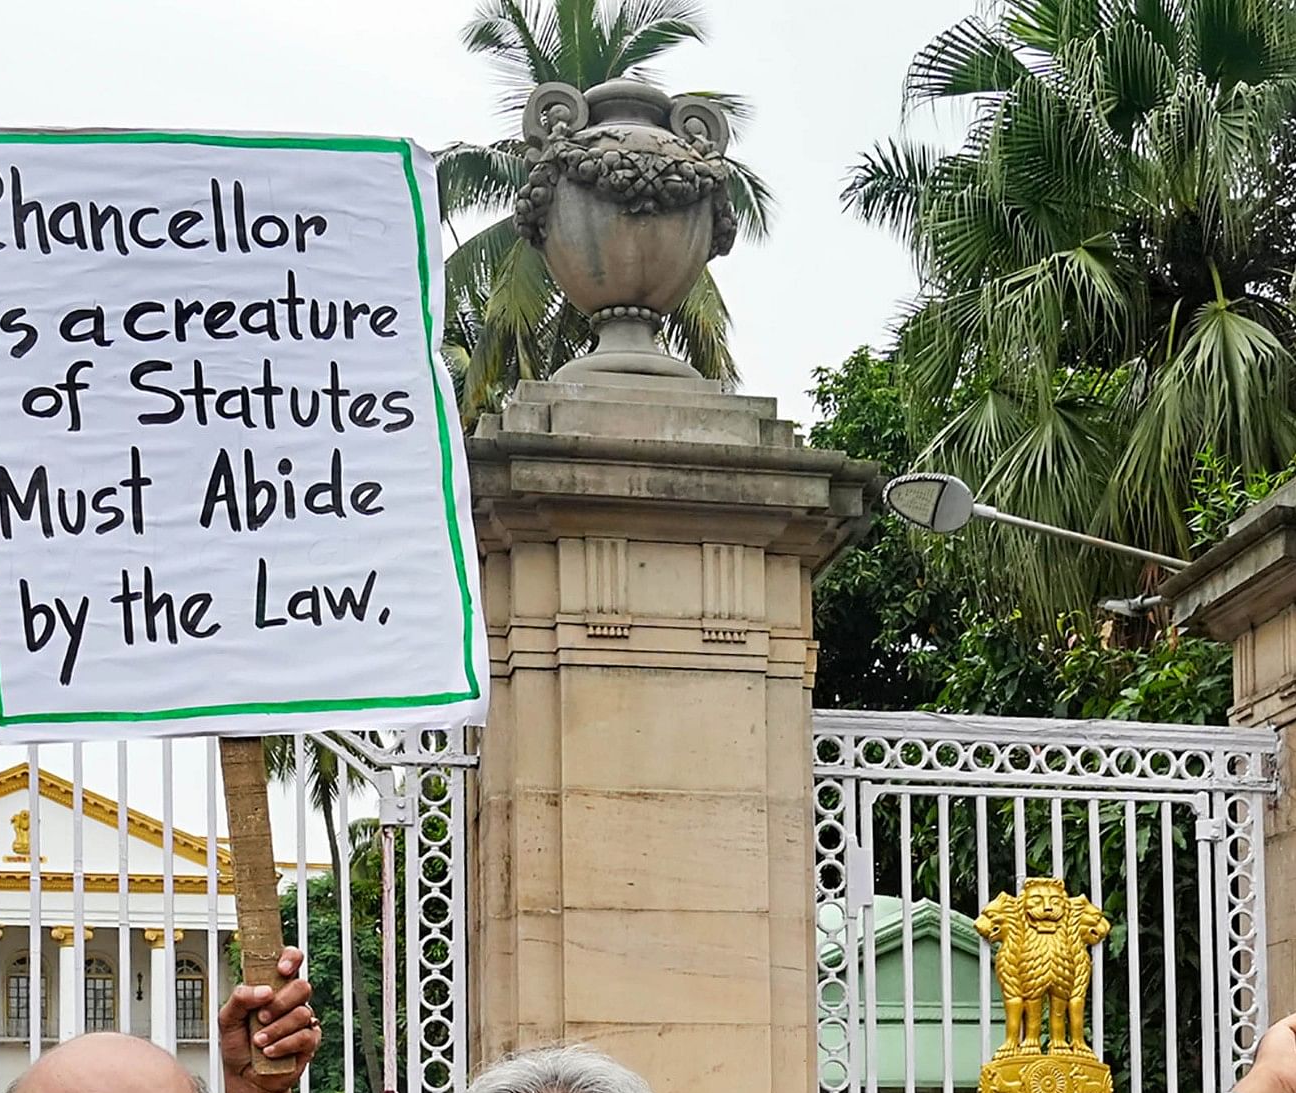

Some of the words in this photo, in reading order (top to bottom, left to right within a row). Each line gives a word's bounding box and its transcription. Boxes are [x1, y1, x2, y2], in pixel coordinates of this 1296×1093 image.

[59, 305, 114, 347] a
[123, 269, 399, 343] creature
[23, 360, 94, 432] of
[130, 358, 415, 433] Statutes
[200, 448, 385, 532] Abide
[20, 579, 89, 686] by
[110, 566, 221, 645] the
[255, 558, 391, 630] Law.
